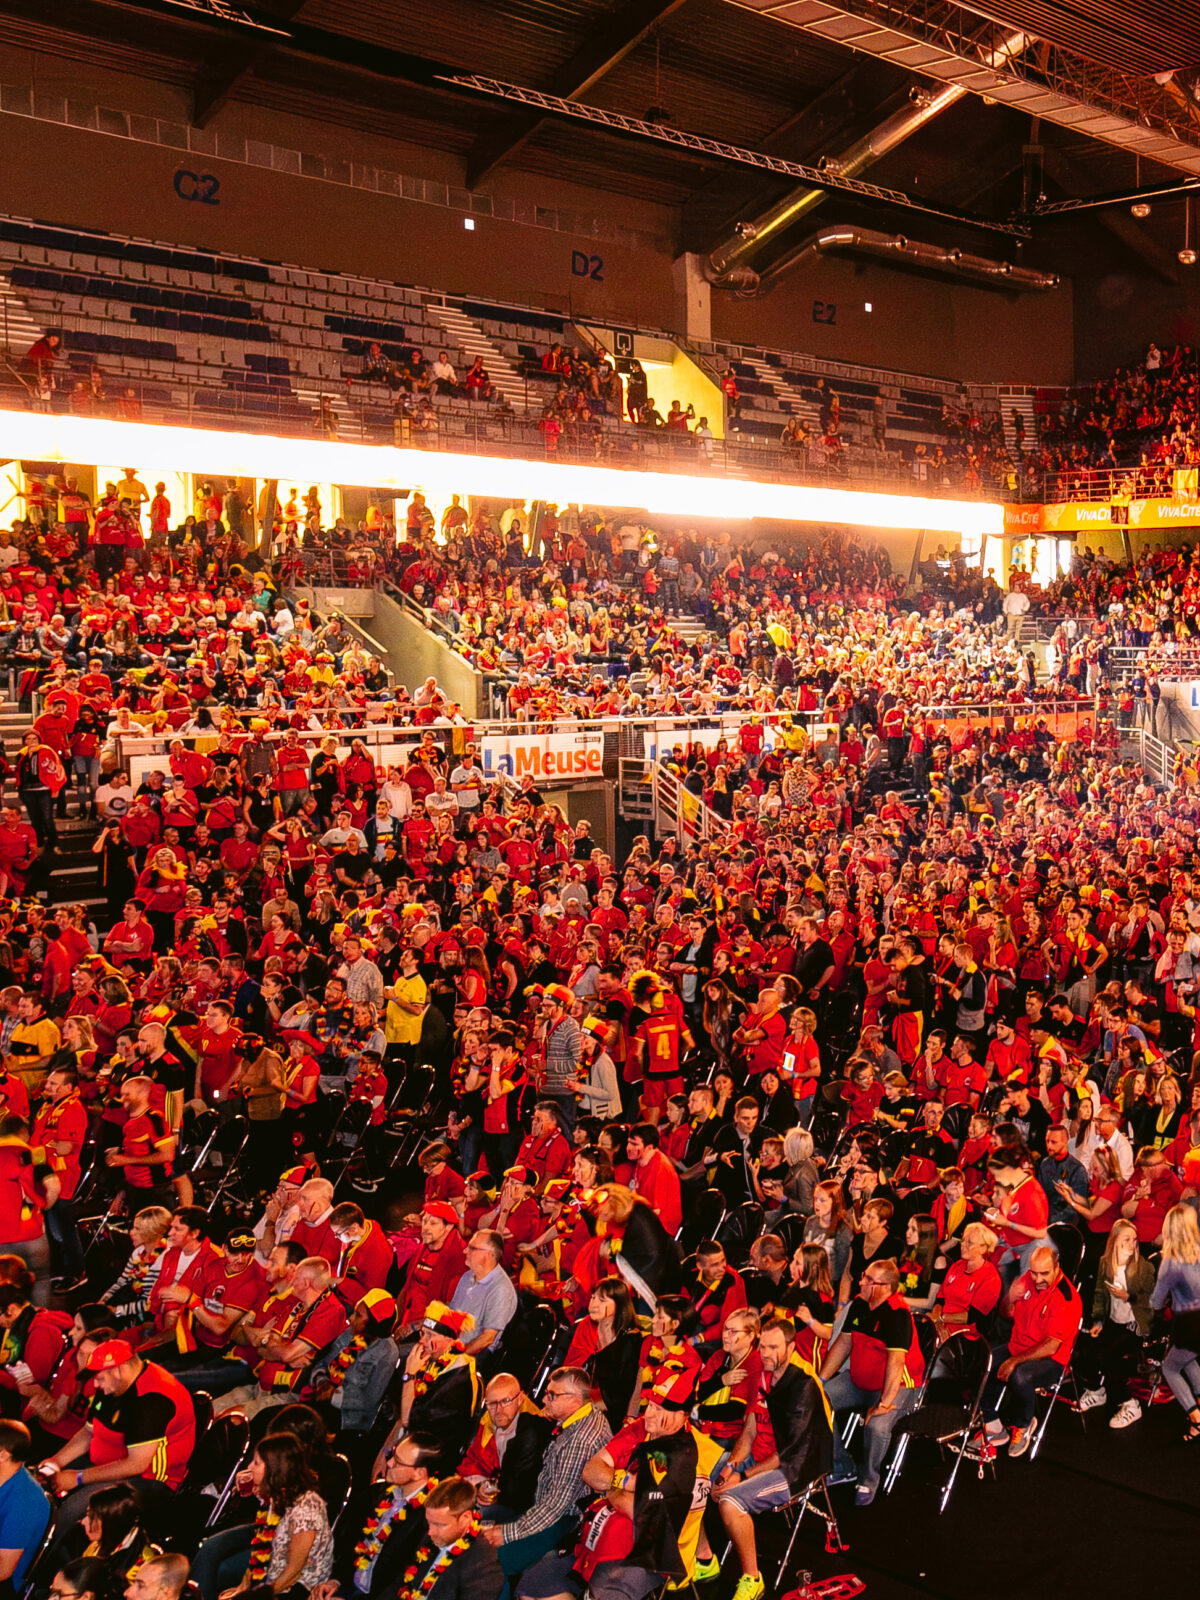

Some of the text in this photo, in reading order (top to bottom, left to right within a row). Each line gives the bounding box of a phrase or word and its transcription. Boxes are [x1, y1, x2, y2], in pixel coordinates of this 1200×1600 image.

[174, 169, 220, 205] C2
[572, 250, 604, 281] D2
[812, 301, 837, 325] E2
[916, 1159, 923, 1173] 7
[588, 1511, 609, 1549] Jupiler
